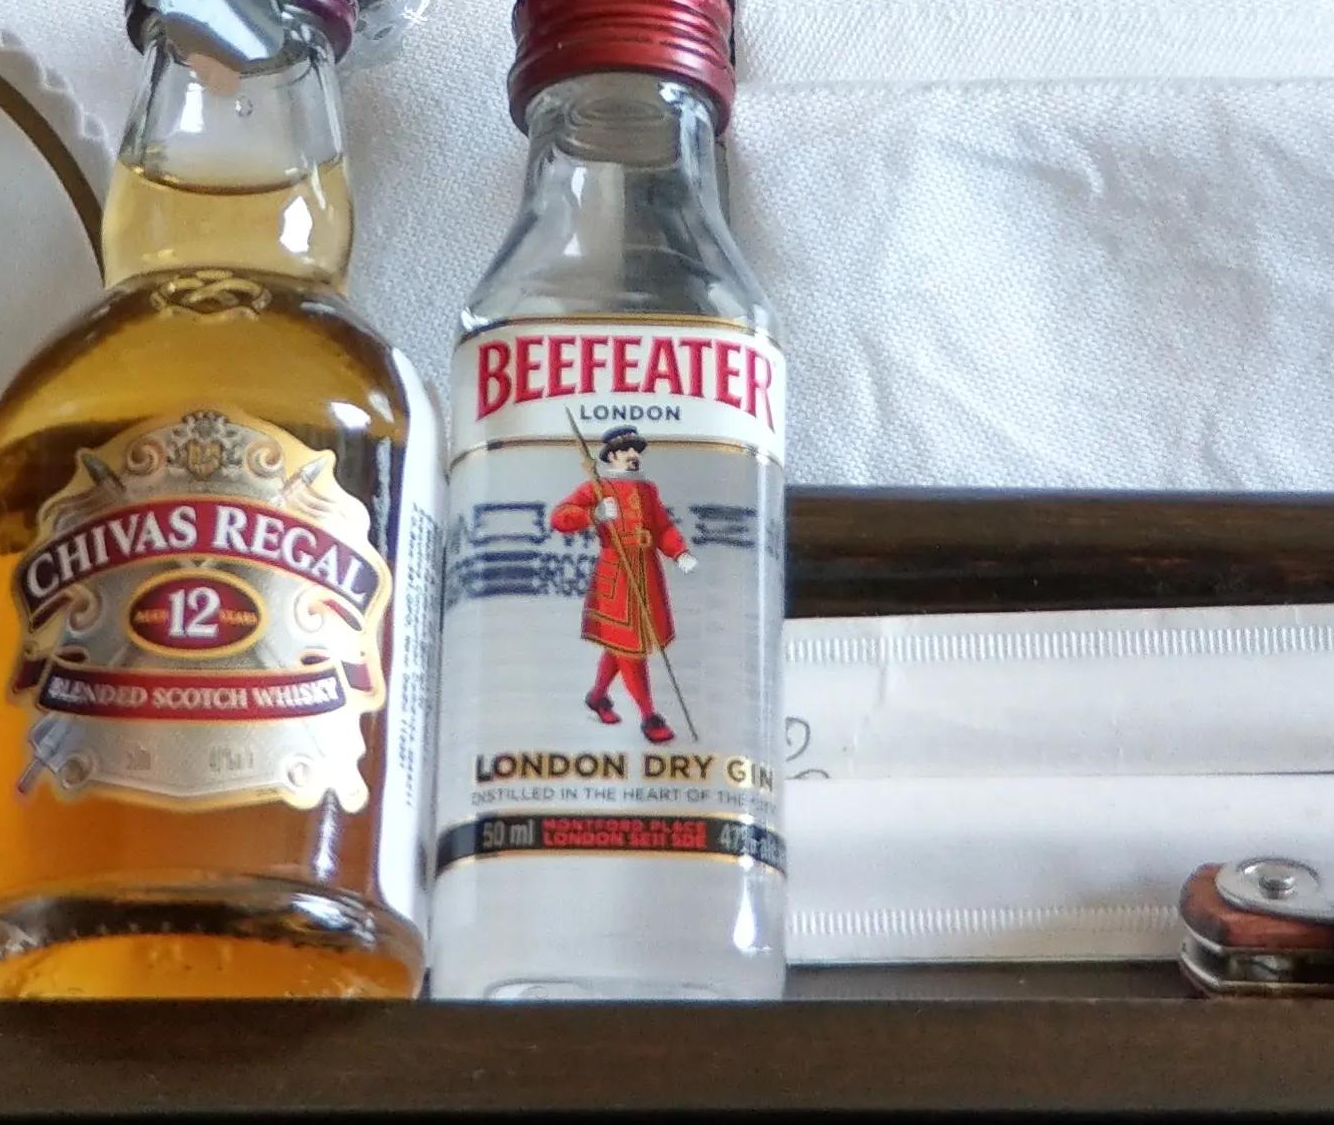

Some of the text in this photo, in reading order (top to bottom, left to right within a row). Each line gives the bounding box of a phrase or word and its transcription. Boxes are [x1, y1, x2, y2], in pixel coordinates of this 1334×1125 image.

[475, 335, 775, 434] BEEFEATER
[580, 405, 681, 421] LONDON
[27, 505, 198, 600] CHIVAS
[212, 505, 368, 602] REGAL
[169, 586, 221, 637] 12
[47, 676, 339, 710] BLENDED SCOTCH WHISKY
[475, 754, 773, 792] LONDON DRY GIN
[561, 786, 577, 802] IN
[585, 786, 616, 802] THE
[623, 786, 680, 802] HEART
[510, 819, 535, 847] ml
[543, 832, 624, 848] LONDON
